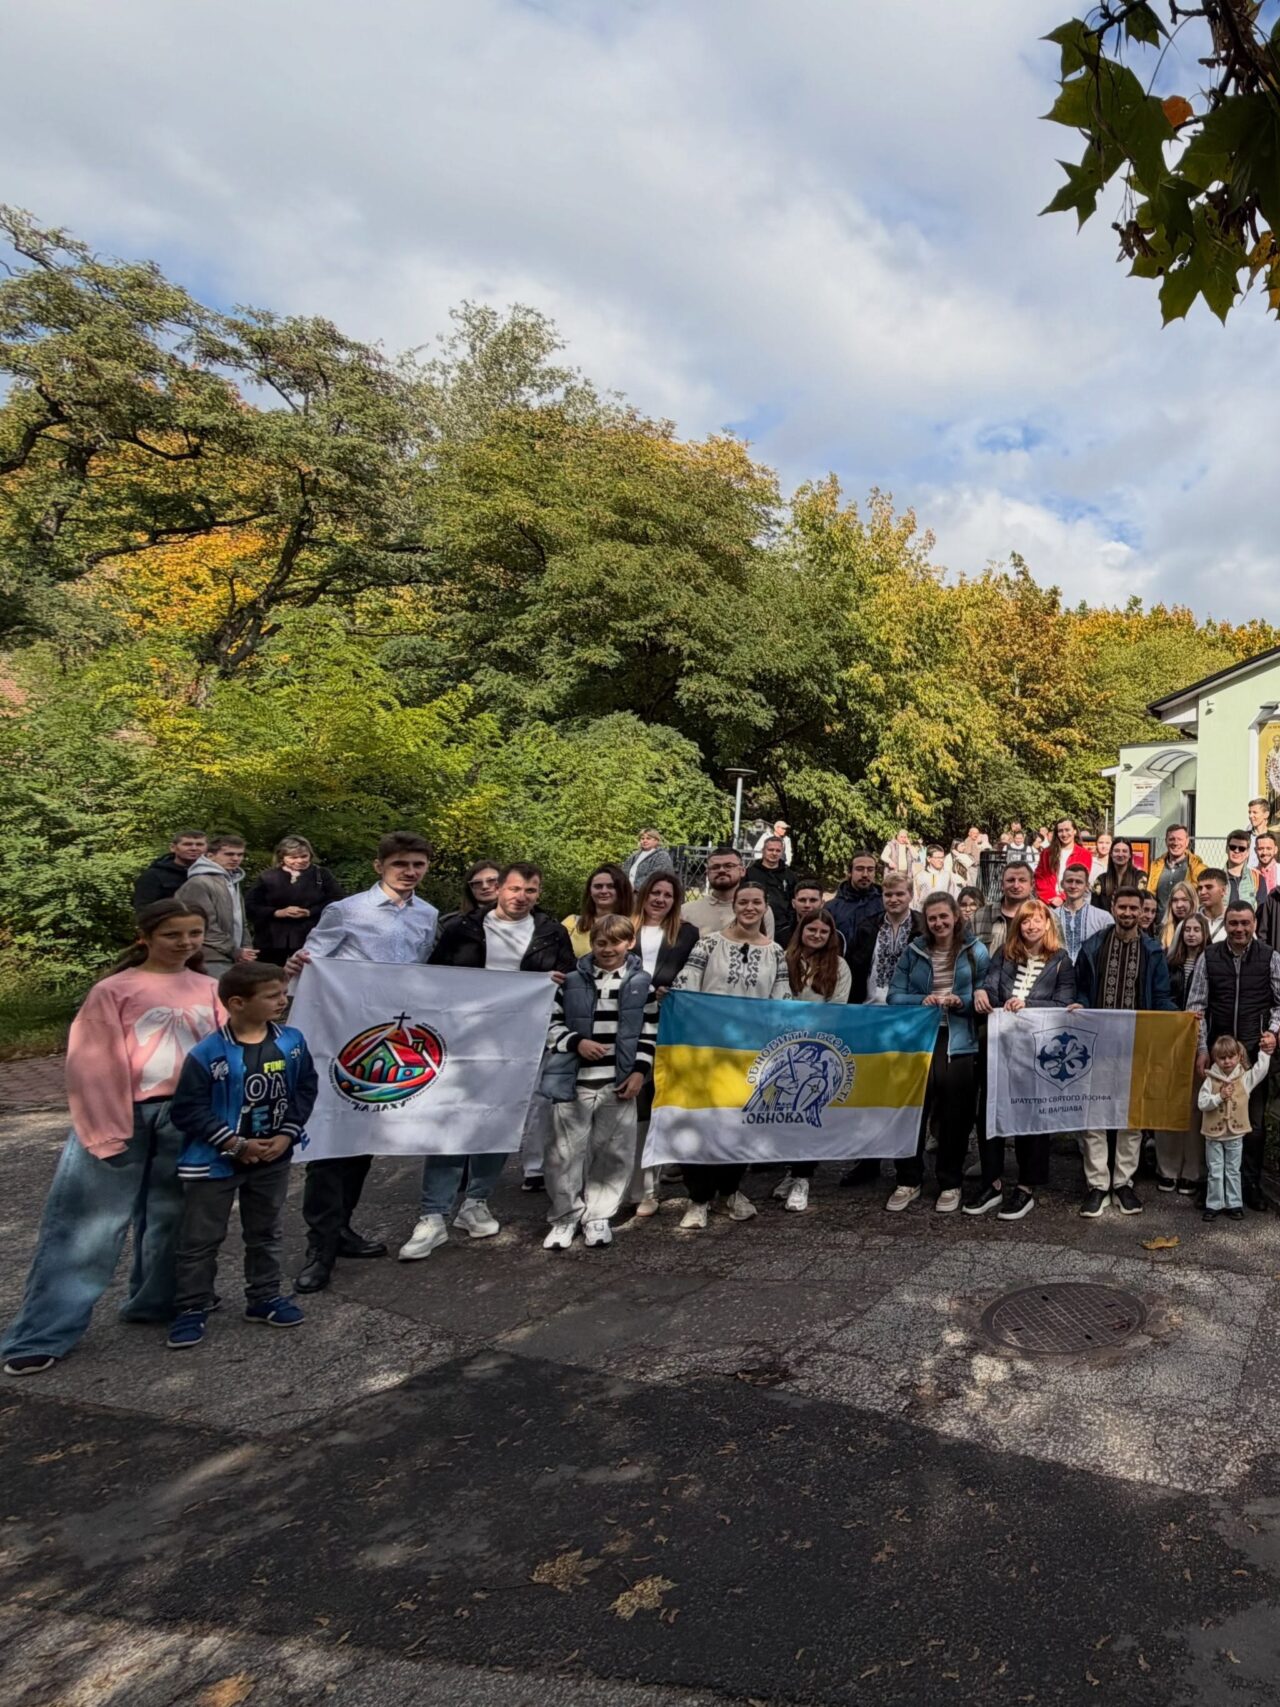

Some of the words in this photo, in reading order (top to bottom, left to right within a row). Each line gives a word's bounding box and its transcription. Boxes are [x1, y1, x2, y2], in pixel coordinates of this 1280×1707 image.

[1010, 1097, 1047, 1105] БРАТСТВО
[1048, 1094, 1080, 1103] СВЯТОГО
[1048, 1105, 1083, 1114] ВАРШАВА
